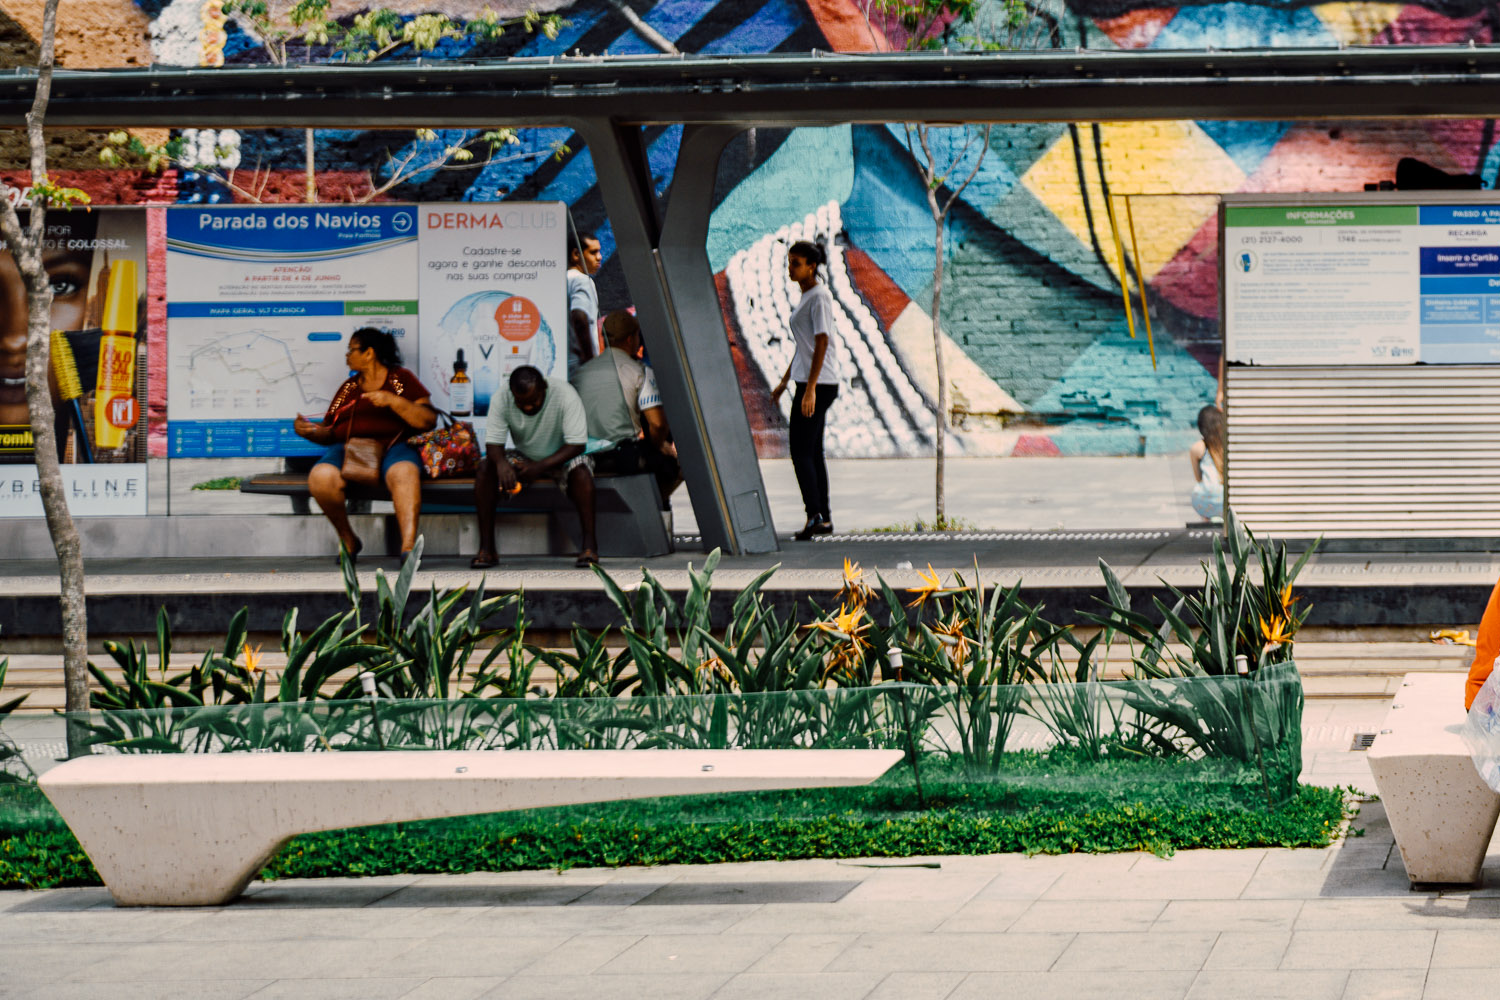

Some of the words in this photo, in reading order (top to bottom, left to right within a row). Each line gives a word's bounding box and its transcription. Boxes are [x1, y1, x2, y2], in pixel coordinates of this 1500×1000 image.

[1286, 210, 1355, 220] INFORMAÇÕES
[1453, 210, 1479, 218] PASSO
[199, 212, 267, 230] Parada
[273, 212, 309, 229] dos
[315, 211, 381, 229] Navios
[1241, 236, 1257, 244] (21)
[1259, 235, 1303, 244] 2127-4000
[67, 239, 130, 251] COLOSSAL
[462, 246, 522, 256] Cadastre-se
[1471, 253, 1499, 262] Cartão
[428, 260, 458, 270] agora
[462, 260, 469, 268] e
[472, 258, 503, 270] ganhe
[507, 258, 557, 268] descontos
[273, 265, 312, 274] ATENÇÃO!
[314, 274, 341, 282] JUNHO
[446, 272, 464, 280] nas
[468, 272, 489, 280] suas
[493, 271, 538, 281] compras!
